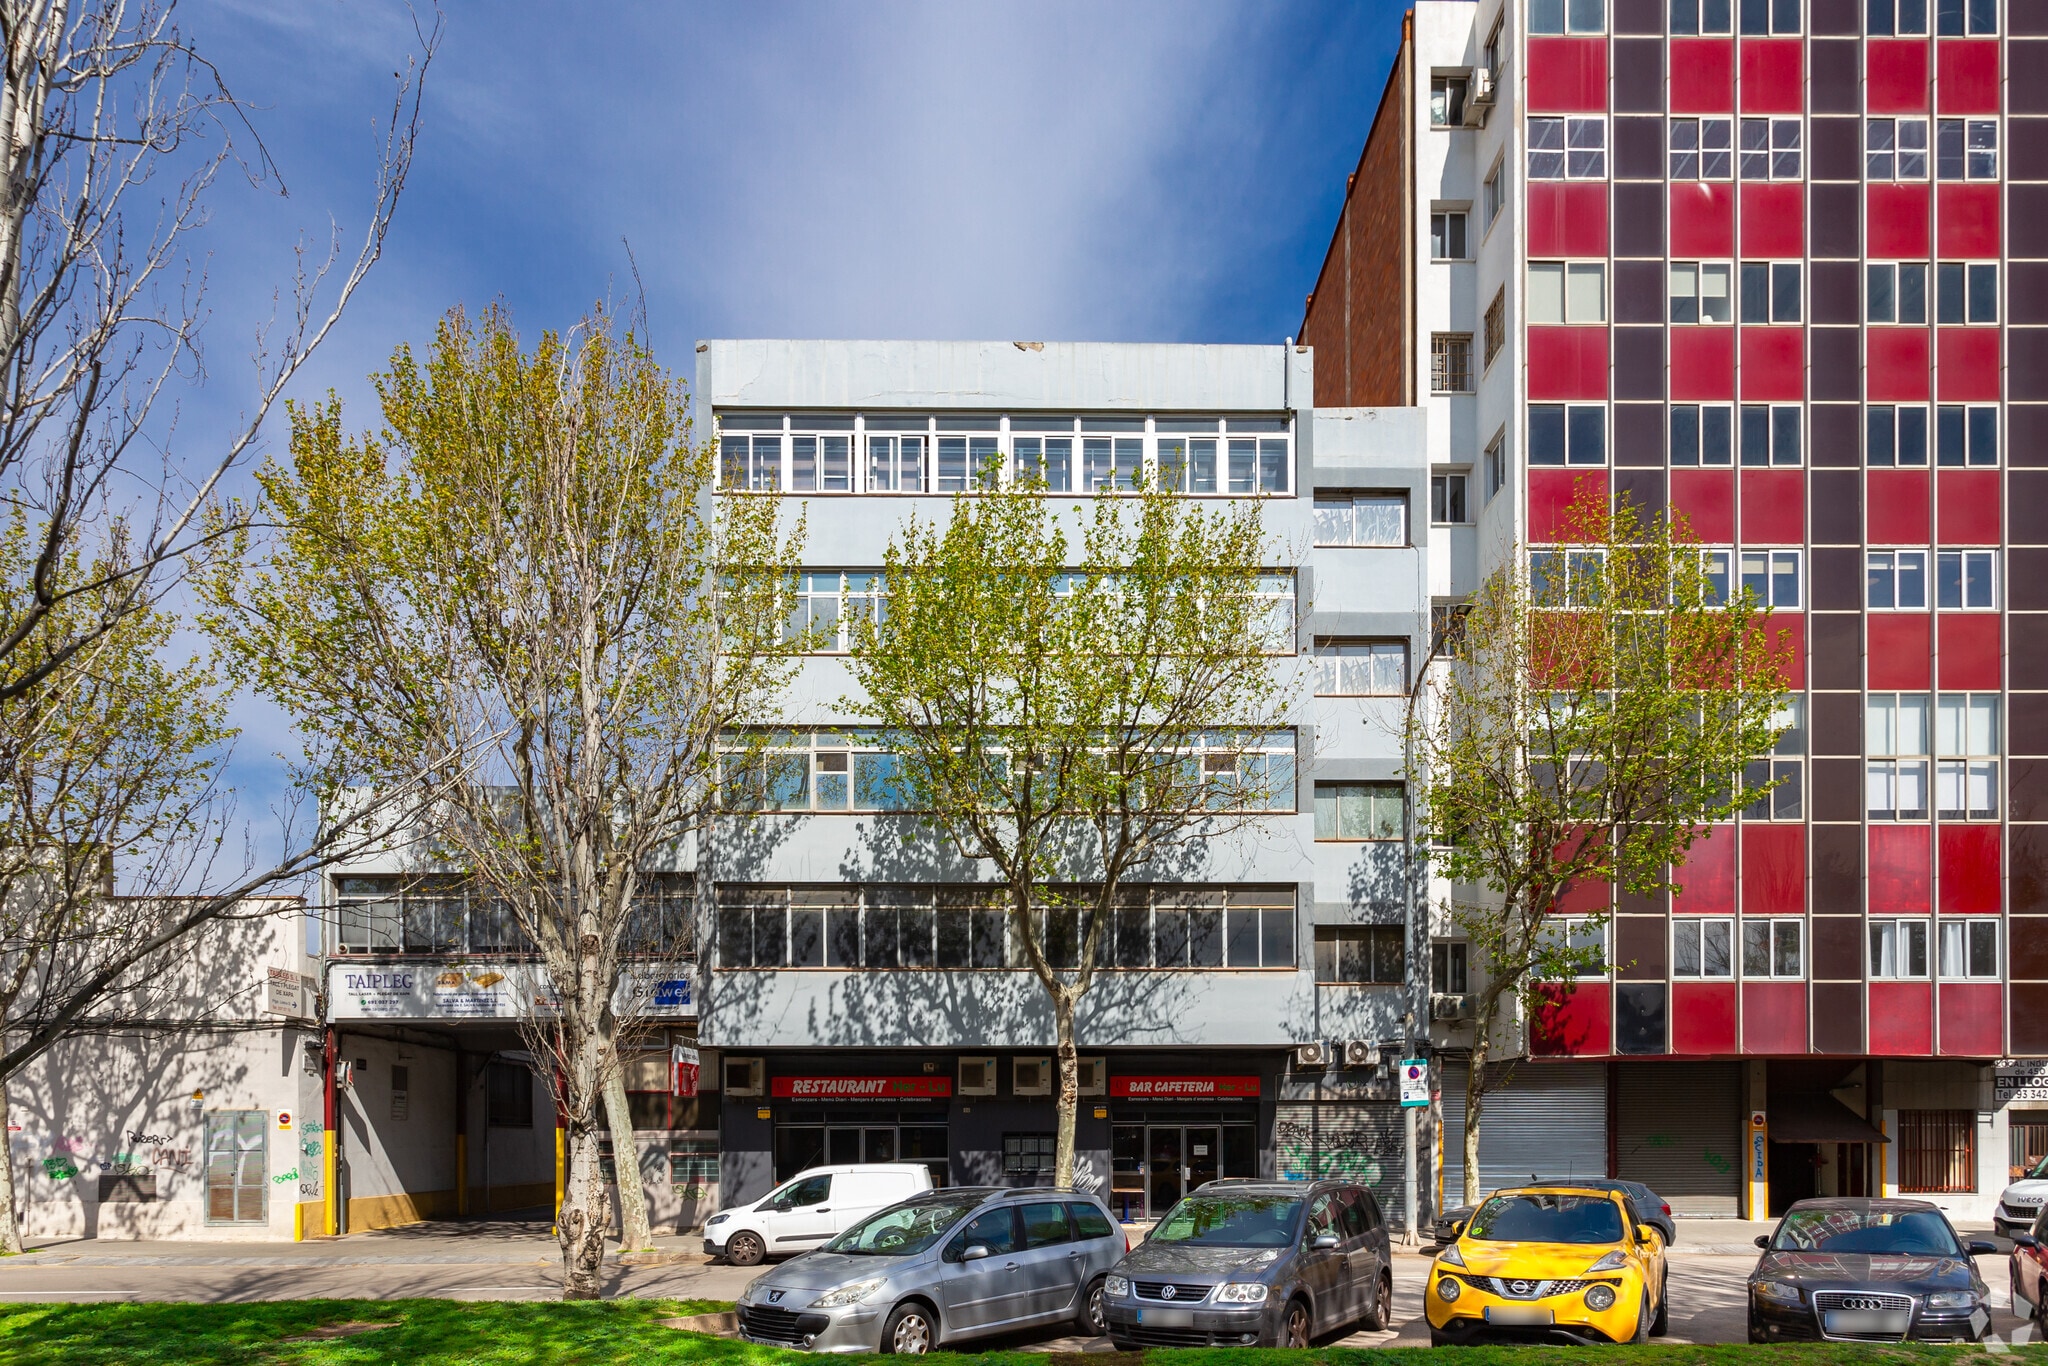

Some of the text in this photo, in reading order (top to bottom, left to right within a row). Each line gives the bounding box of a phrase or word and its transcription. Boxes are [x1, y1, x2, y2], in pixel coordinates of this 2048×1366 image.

[344, 974, 414, 989] TAIPLEG
[2014, 1067, 2046, 1076] de 450
[792, 1079, 887, 1094] RESTAURANT
[892, 1081, 916, 1093] Her
[928, 1080, 946, 1093] Lu
[1129, 1081, 1153, 1093] BAR
[1154, 1081, 1215, 1093] CAFETERIA
[1997, 1077, 2015, 1087] EN
[2016, 1089, 2028, 1099] 93
[2030, 1089, 2048, 1099] 342
